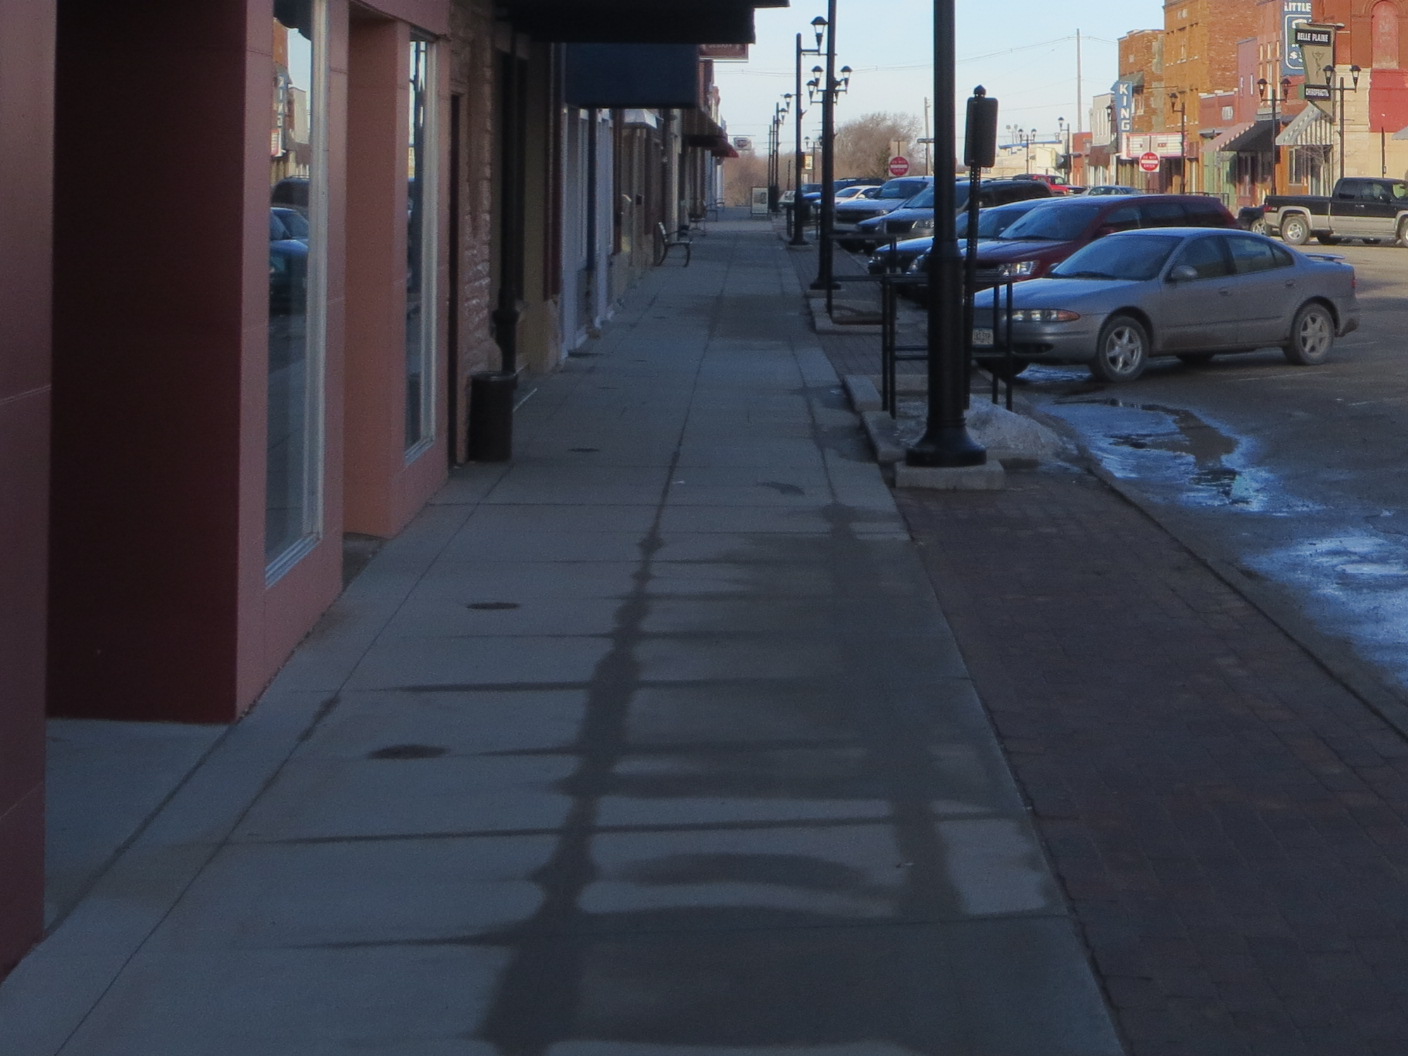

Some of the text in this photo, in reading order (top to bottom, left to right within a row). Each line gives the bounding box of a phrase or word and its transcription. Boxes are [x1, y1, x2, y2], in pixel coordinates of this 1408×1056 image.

[1284, 2, 1311, 12] LITTLE
[1297, 32, 1328, 42] BELLE PLAINE
[1119, 83, 1130, 131] KING
